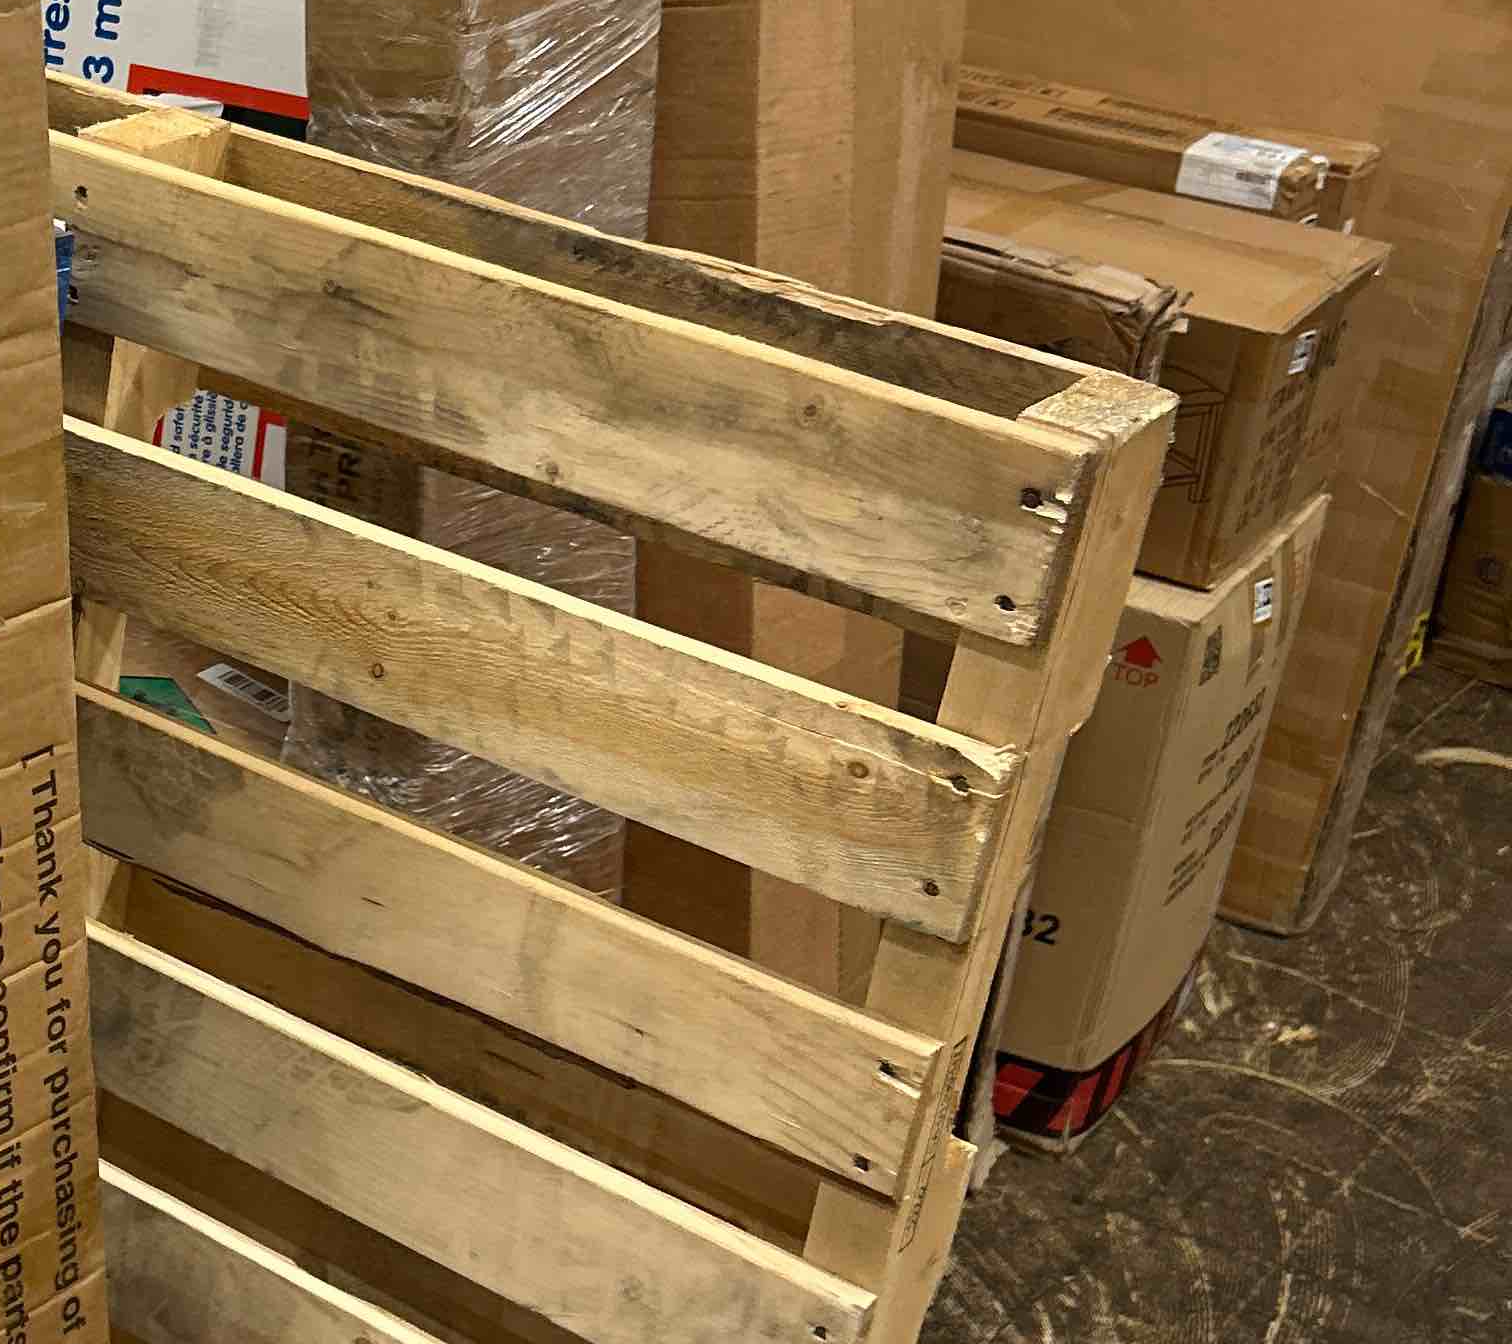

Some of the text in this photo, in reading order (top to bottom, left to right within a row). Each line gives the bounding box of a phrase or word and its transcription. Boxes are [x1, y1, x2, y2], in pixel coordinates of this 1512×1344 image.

[82, 55, 114, 84] 3
[1110, 665, 1161, 689] TOP
[19, 744, 55, 770] [
[31, 768, 59, 907] Thank
[34, 911, 63, 992] you
[46, 999, 73, 1056] for
[43, 1067, 82, 1291] purchasing
[61, 1296, 85, 1336] of
